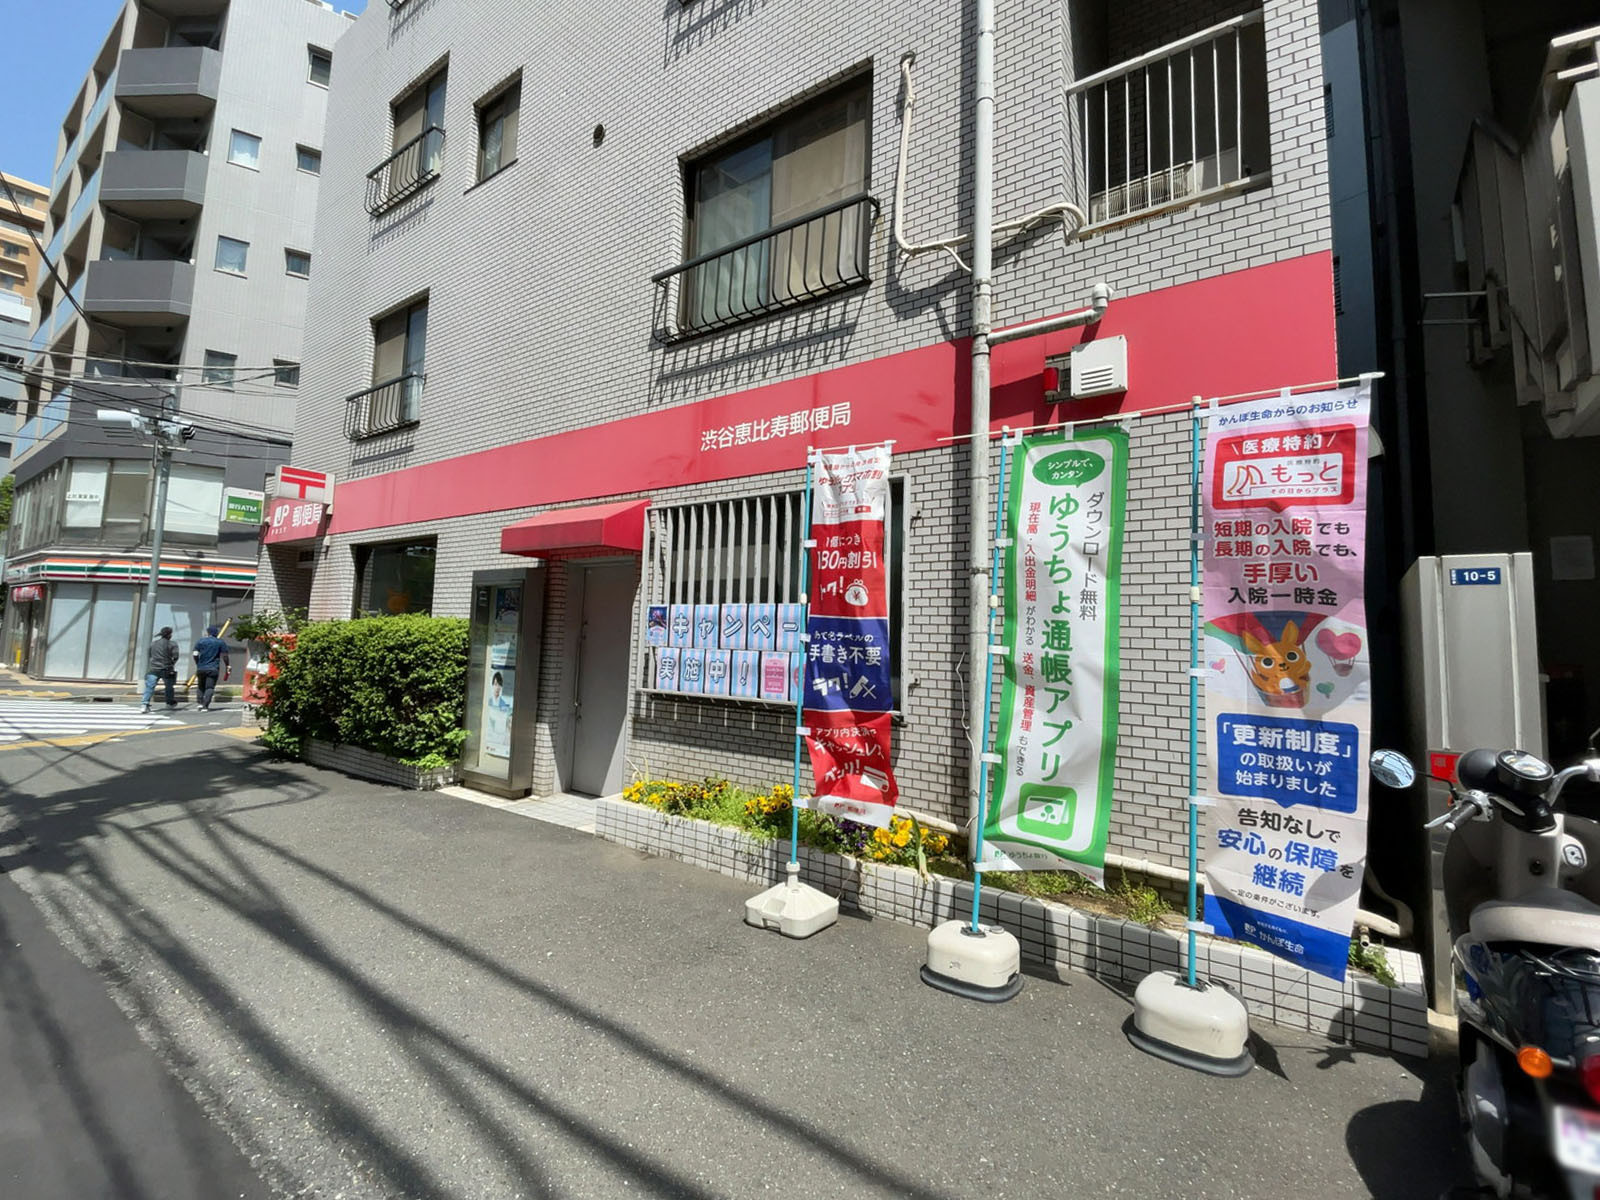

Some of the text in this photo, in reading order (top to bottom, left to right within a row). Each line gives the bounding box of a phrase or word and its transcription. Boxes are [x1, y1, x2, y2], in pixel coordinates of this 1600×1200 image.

[1217, 398, 1358, 426] かんぽ生命からのお知らせ
[700, 401, 852, 452] 渋谷恵比寿郵便局
[1242, 433, 1323, 455] 医療特約
[1051, 470, 1083, 480] カンタン
[1271, 460, 1338, 484] もっと
[1270, 486, 1338, 495] その日からプラス
[292, 503, 323, 528] 郵便局
[1213, 518, 1351, 538] 短期の入院でも
[825, 533, 861, 549] 1個につき
[1213, 538, 1358, 557] 長期の入院でも、
[1079, 491, 1105, 621] ダウンロード無料
[1243, 562, 1319, 584] 手厚い
[1463, 570, 1496, 582] 10-5
[1227, 586, 1338, 606] 入院一時金
[1040, 492, 1080, 782] ゆうちょ通帳アプリ
[809, 644, 882, 666] 手書き不要
[812, 672, 849, 697] ラク!
[1222, 721, 1352, 758] 「更新制度」
[1240, 752, 1332, 777] の取扱いが
[1235, 769, 1337, 798] 始まりました
[1237, 808, 1341, 843] 告知なしで
[1217, 828, 1354, 879] 安心の保障を
[1252, 863, 1307, 897] 継続
[1258, 931, 1304, 955] かんぽ生命
